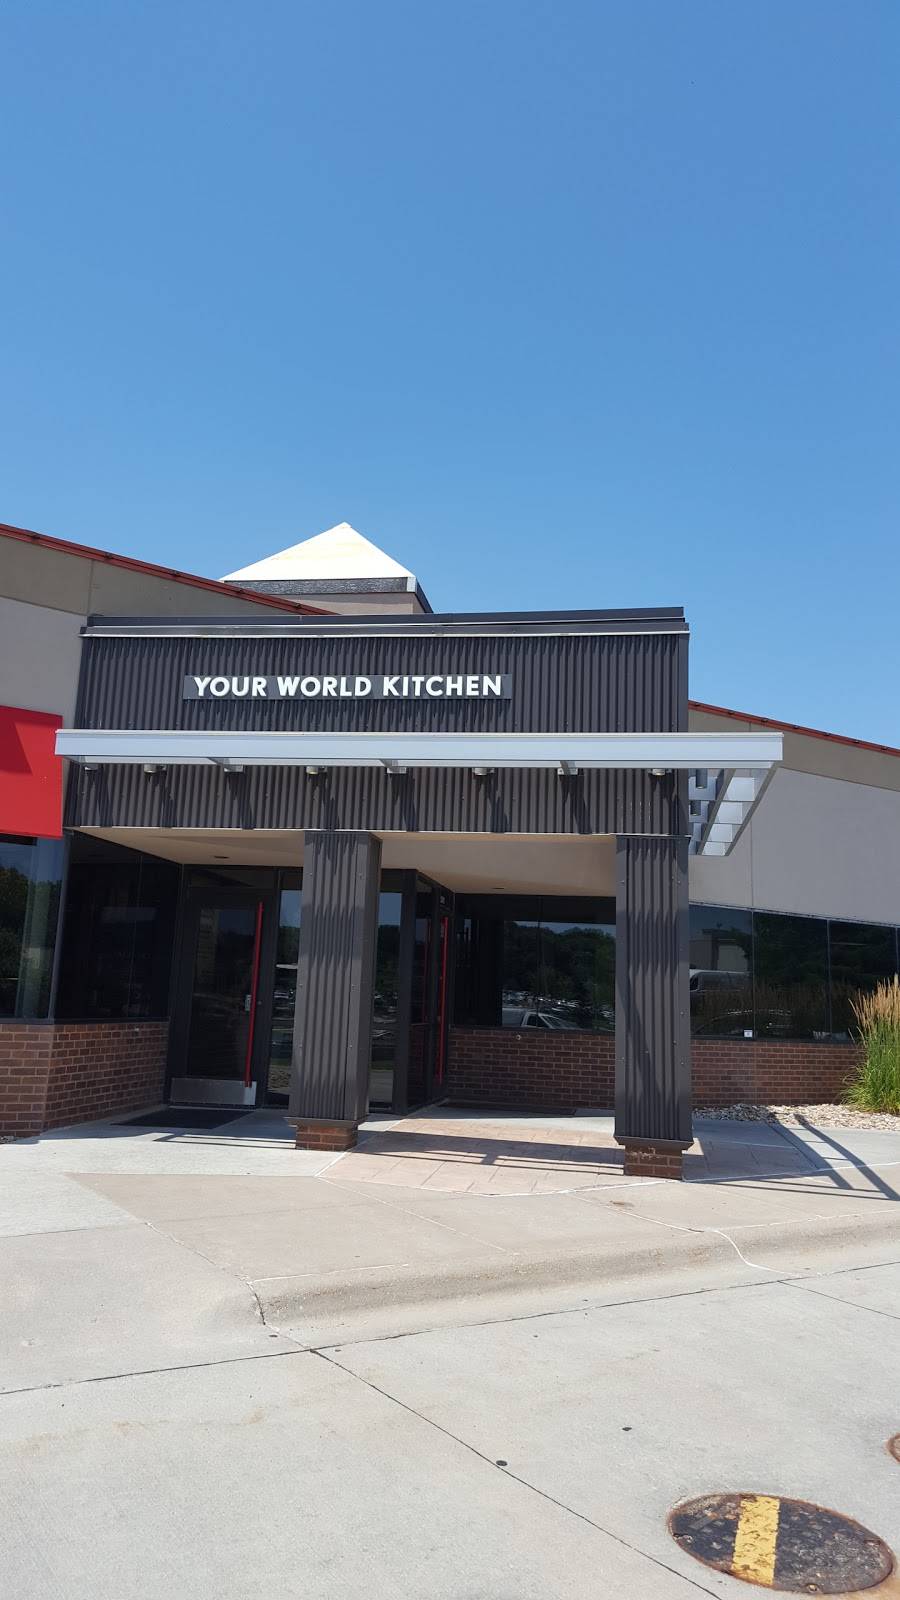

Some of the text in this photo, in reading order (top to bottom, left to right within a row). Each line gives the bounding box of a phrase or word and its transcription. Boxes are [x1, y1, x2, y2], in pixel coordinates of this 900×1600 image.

[193, 675, 502, 697] YOUR WORLD KITCHEN
